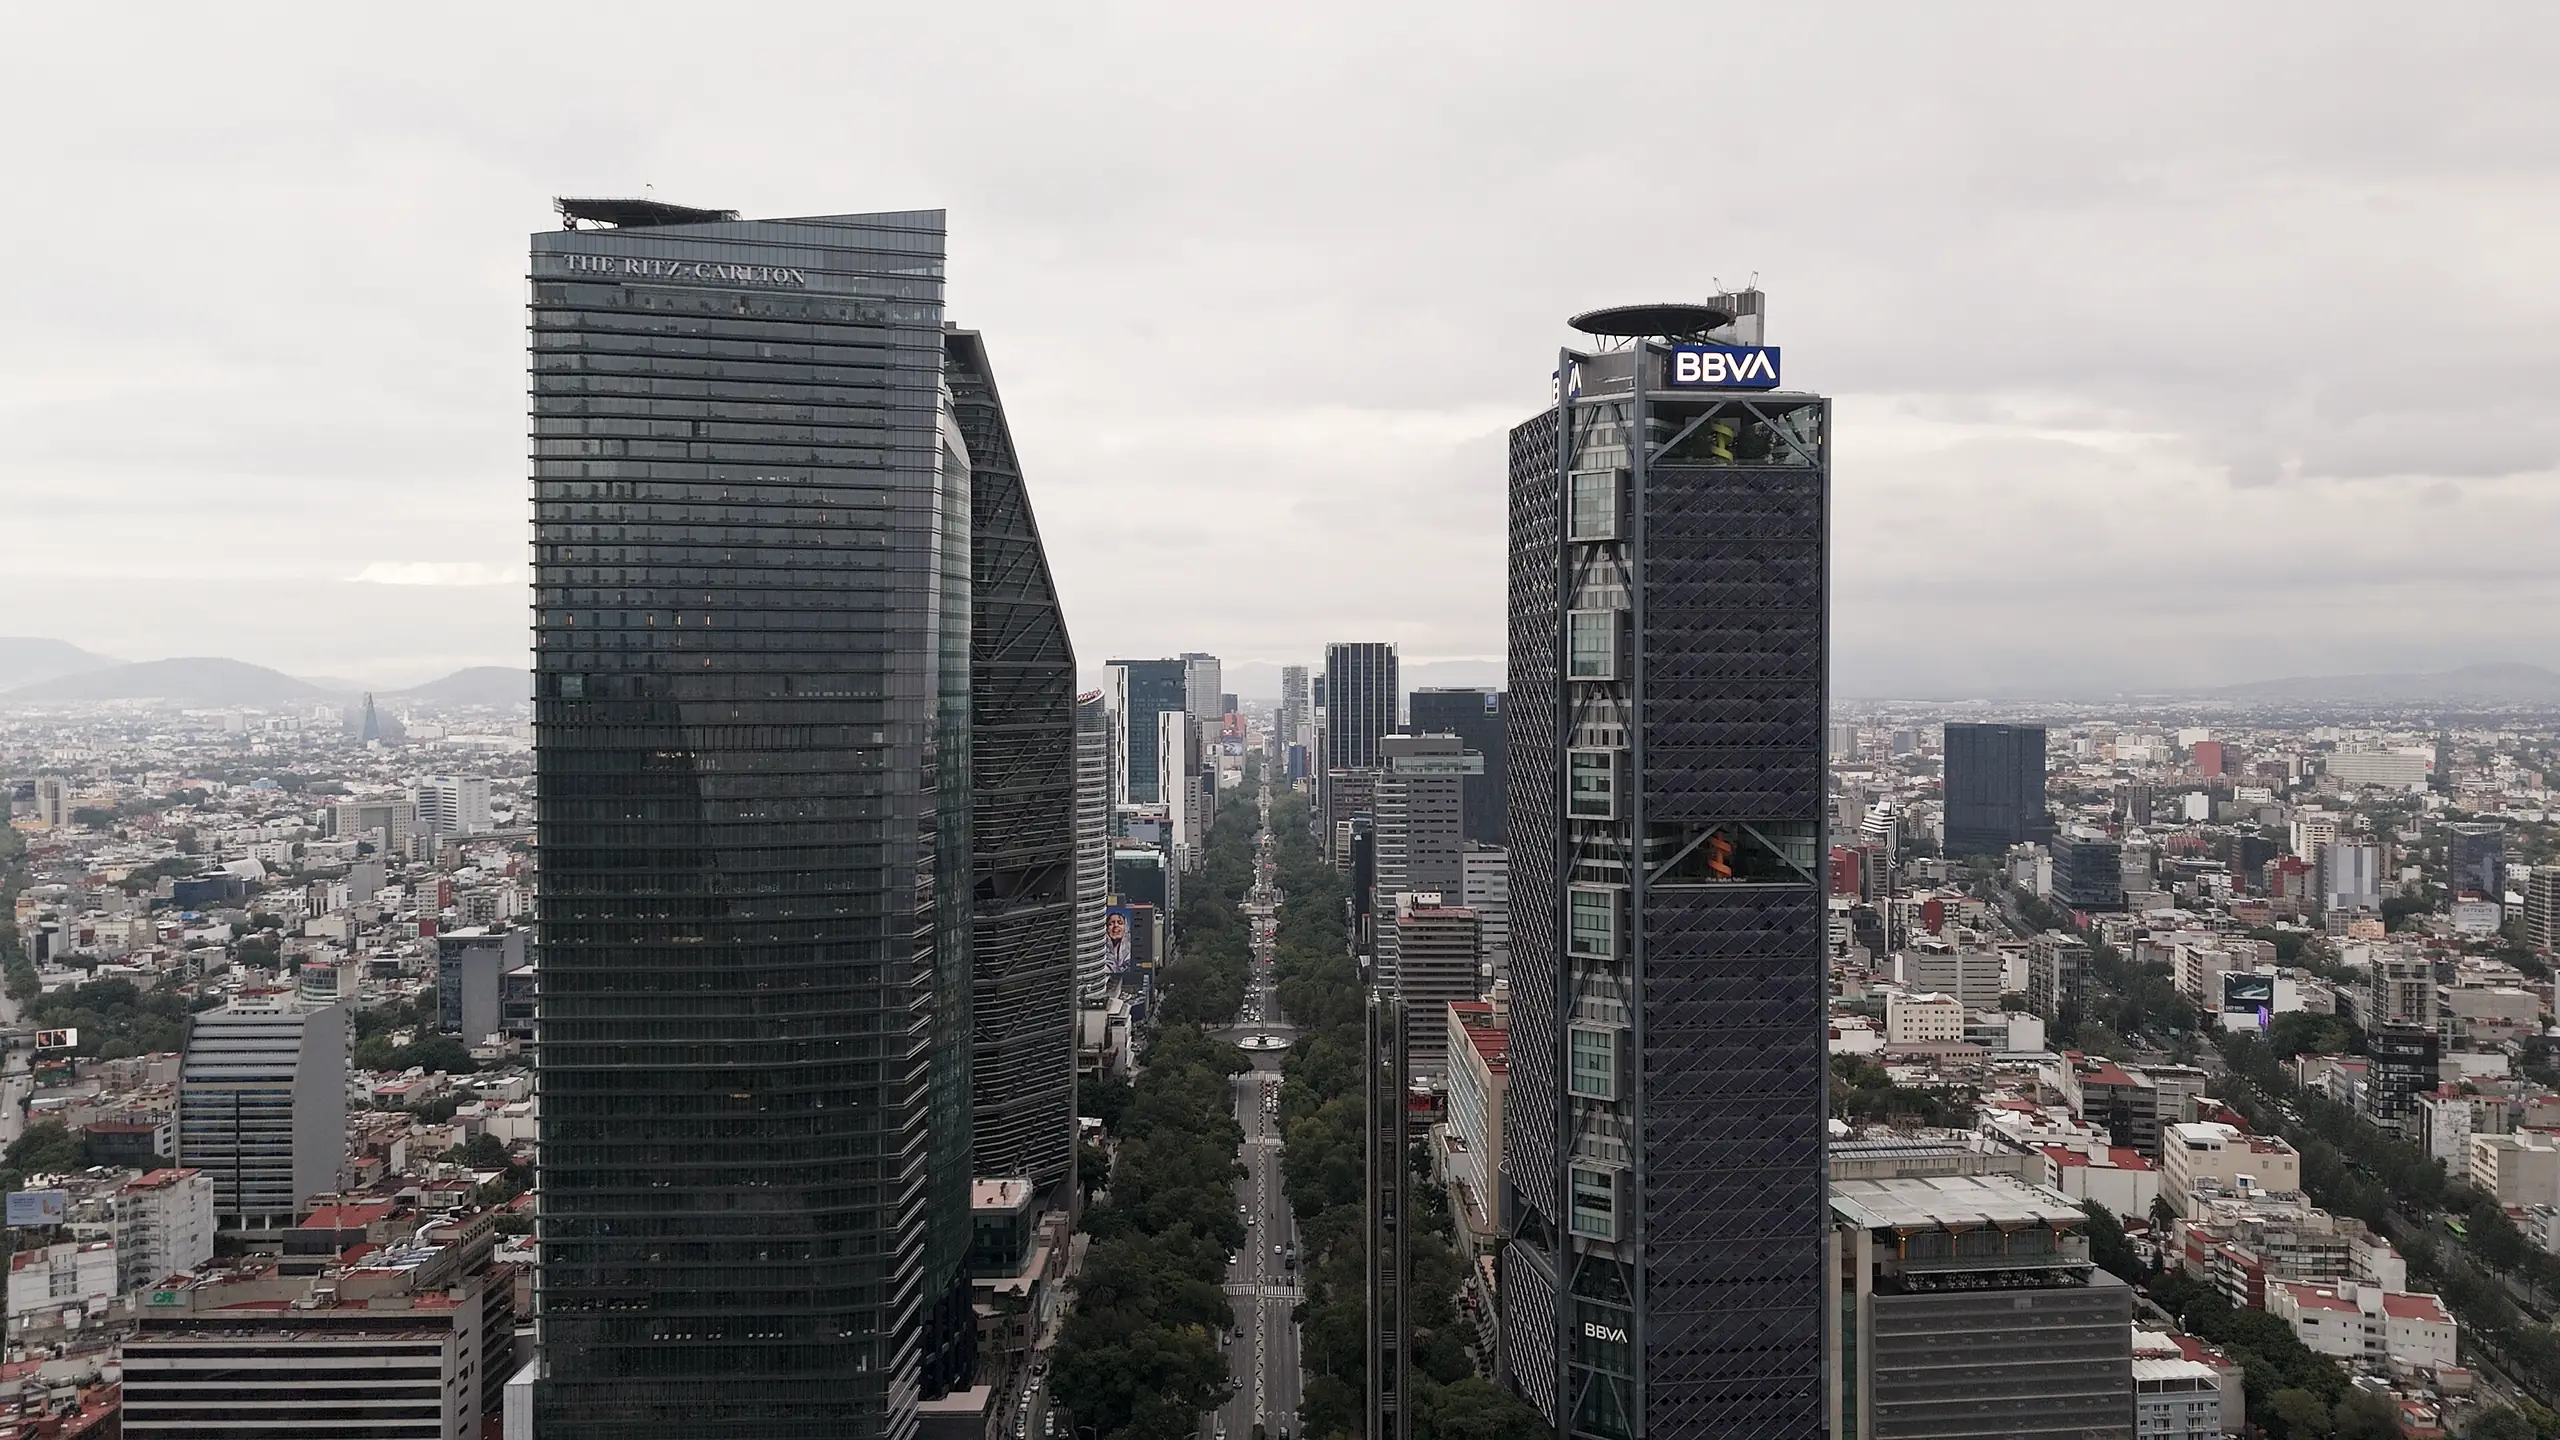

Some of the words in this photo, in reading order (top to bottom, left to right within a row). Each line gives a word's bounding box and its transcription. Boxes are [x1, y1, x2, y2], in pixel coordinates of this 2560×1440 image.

[564, 254, 615, 272] THE
[1676, 349, 1776, 382] BBVA
[1585, 1322, 1628, 1344] BBVA
